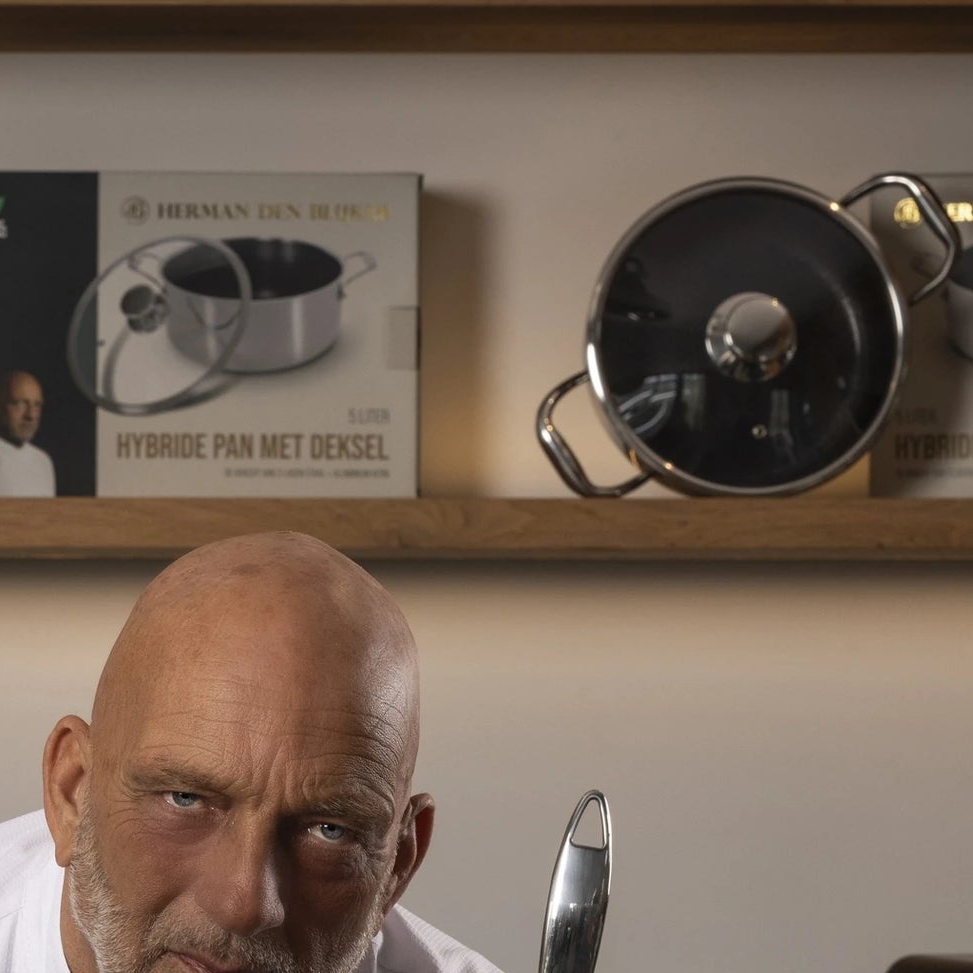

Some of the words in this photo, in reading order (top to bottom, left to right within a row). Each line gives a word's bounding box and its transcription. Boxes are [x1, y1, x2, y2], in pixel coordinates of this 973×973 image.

[157, 203, 249, 220] HERMAN
[258, 203, 301, 220] DEN
[116, 432, 208, 460] HYBRIDE
[213, 432, 254, 460] PAN
[260, 433, 304, 460] MET
[310, 433, 390, 461] DEKSEL
